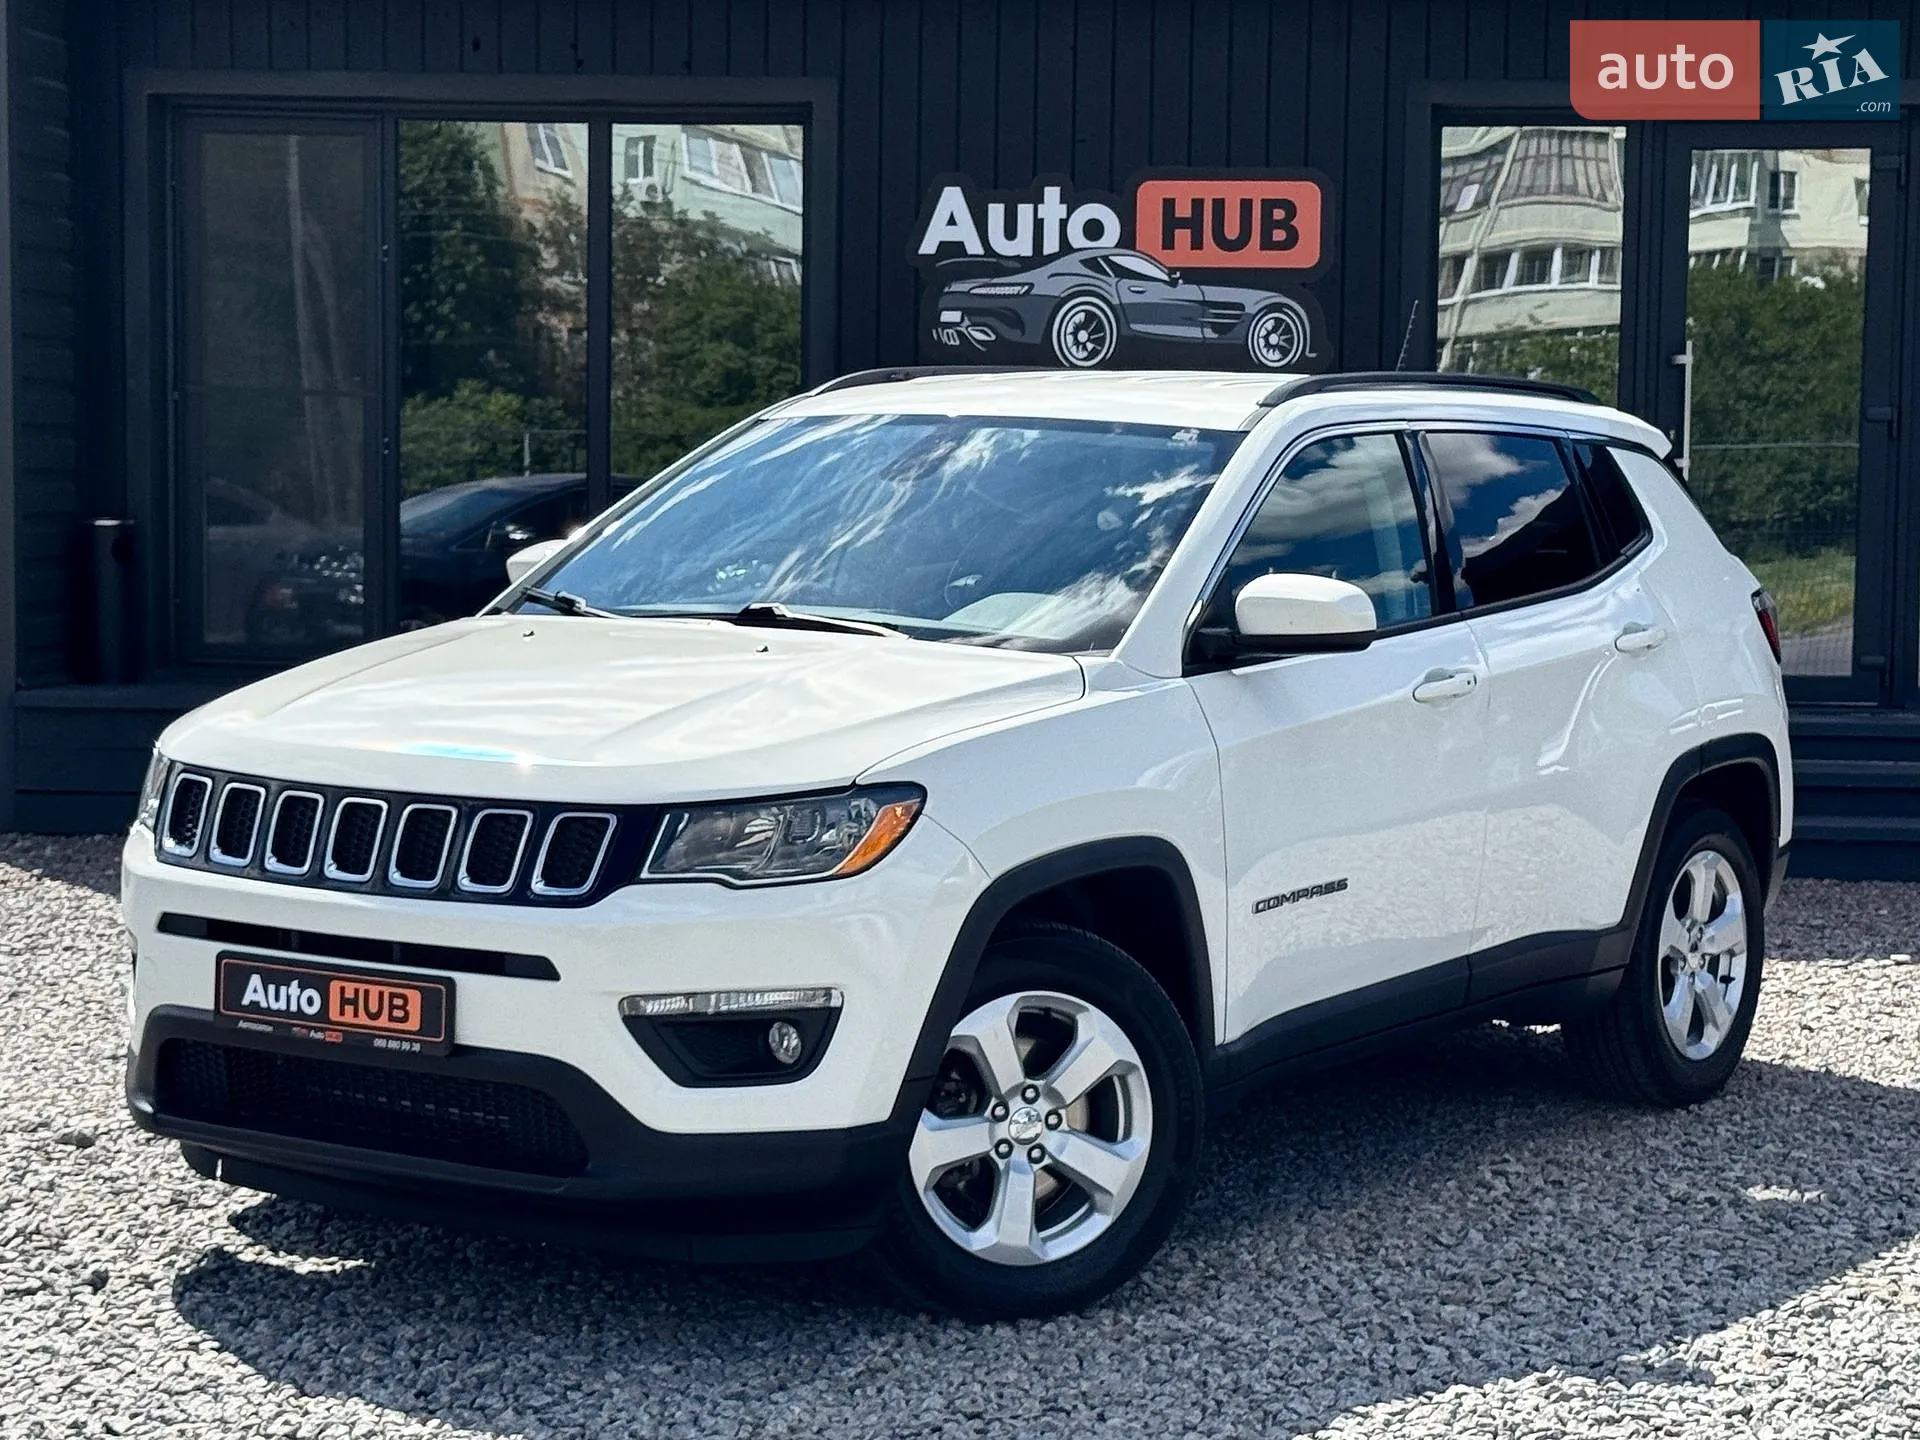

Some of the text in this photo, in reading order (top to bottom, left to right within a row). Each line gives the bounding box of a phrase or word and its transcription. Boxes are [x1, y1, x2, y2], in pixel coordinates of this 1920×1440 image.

[918, 186, 1300, 257] Auto HUB
[1252, 877, 1349, 914] COMPASS
[241, 973, 411, 1024] Auto HUB
